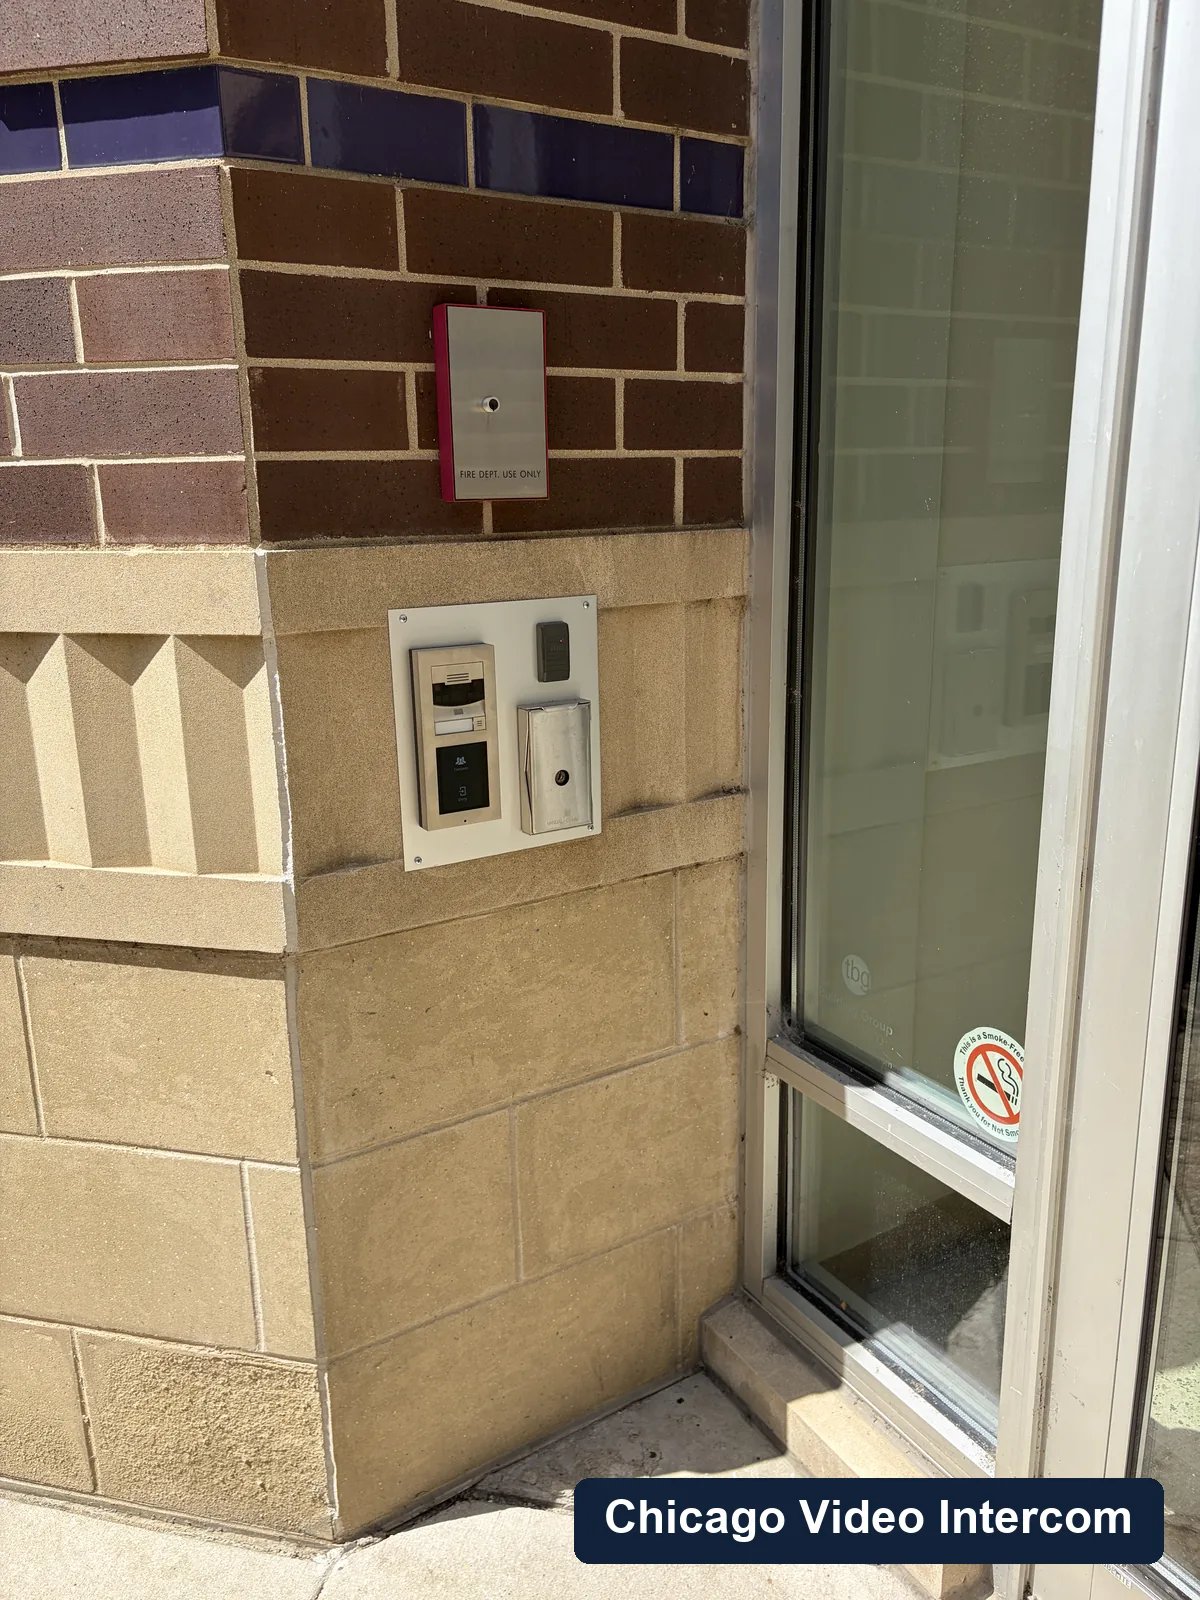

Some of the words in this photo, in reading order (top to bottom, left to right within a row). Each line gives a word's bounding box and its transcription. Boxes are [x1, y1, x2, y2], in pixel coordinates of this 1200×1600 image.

[460, 470, 476, 479] FIRE
[479, 470, 500, 479] DEPT.
[502, 470, 517, 479] USE
[520, 470, 541, 479] ONLY
[844, 959, 870, 994] tbg
[959, 1041, 972, 1056] This
[969, 1036, 977, 1044] is
[982, 1031, 1025, 1063] Smoke-Free
[958, 1076, 970, 1103] Thank
[968, 1103, 981, 1118] you
[980, 1116, 991, 1128] for
[991, 1124, 1004, 1136] Not
